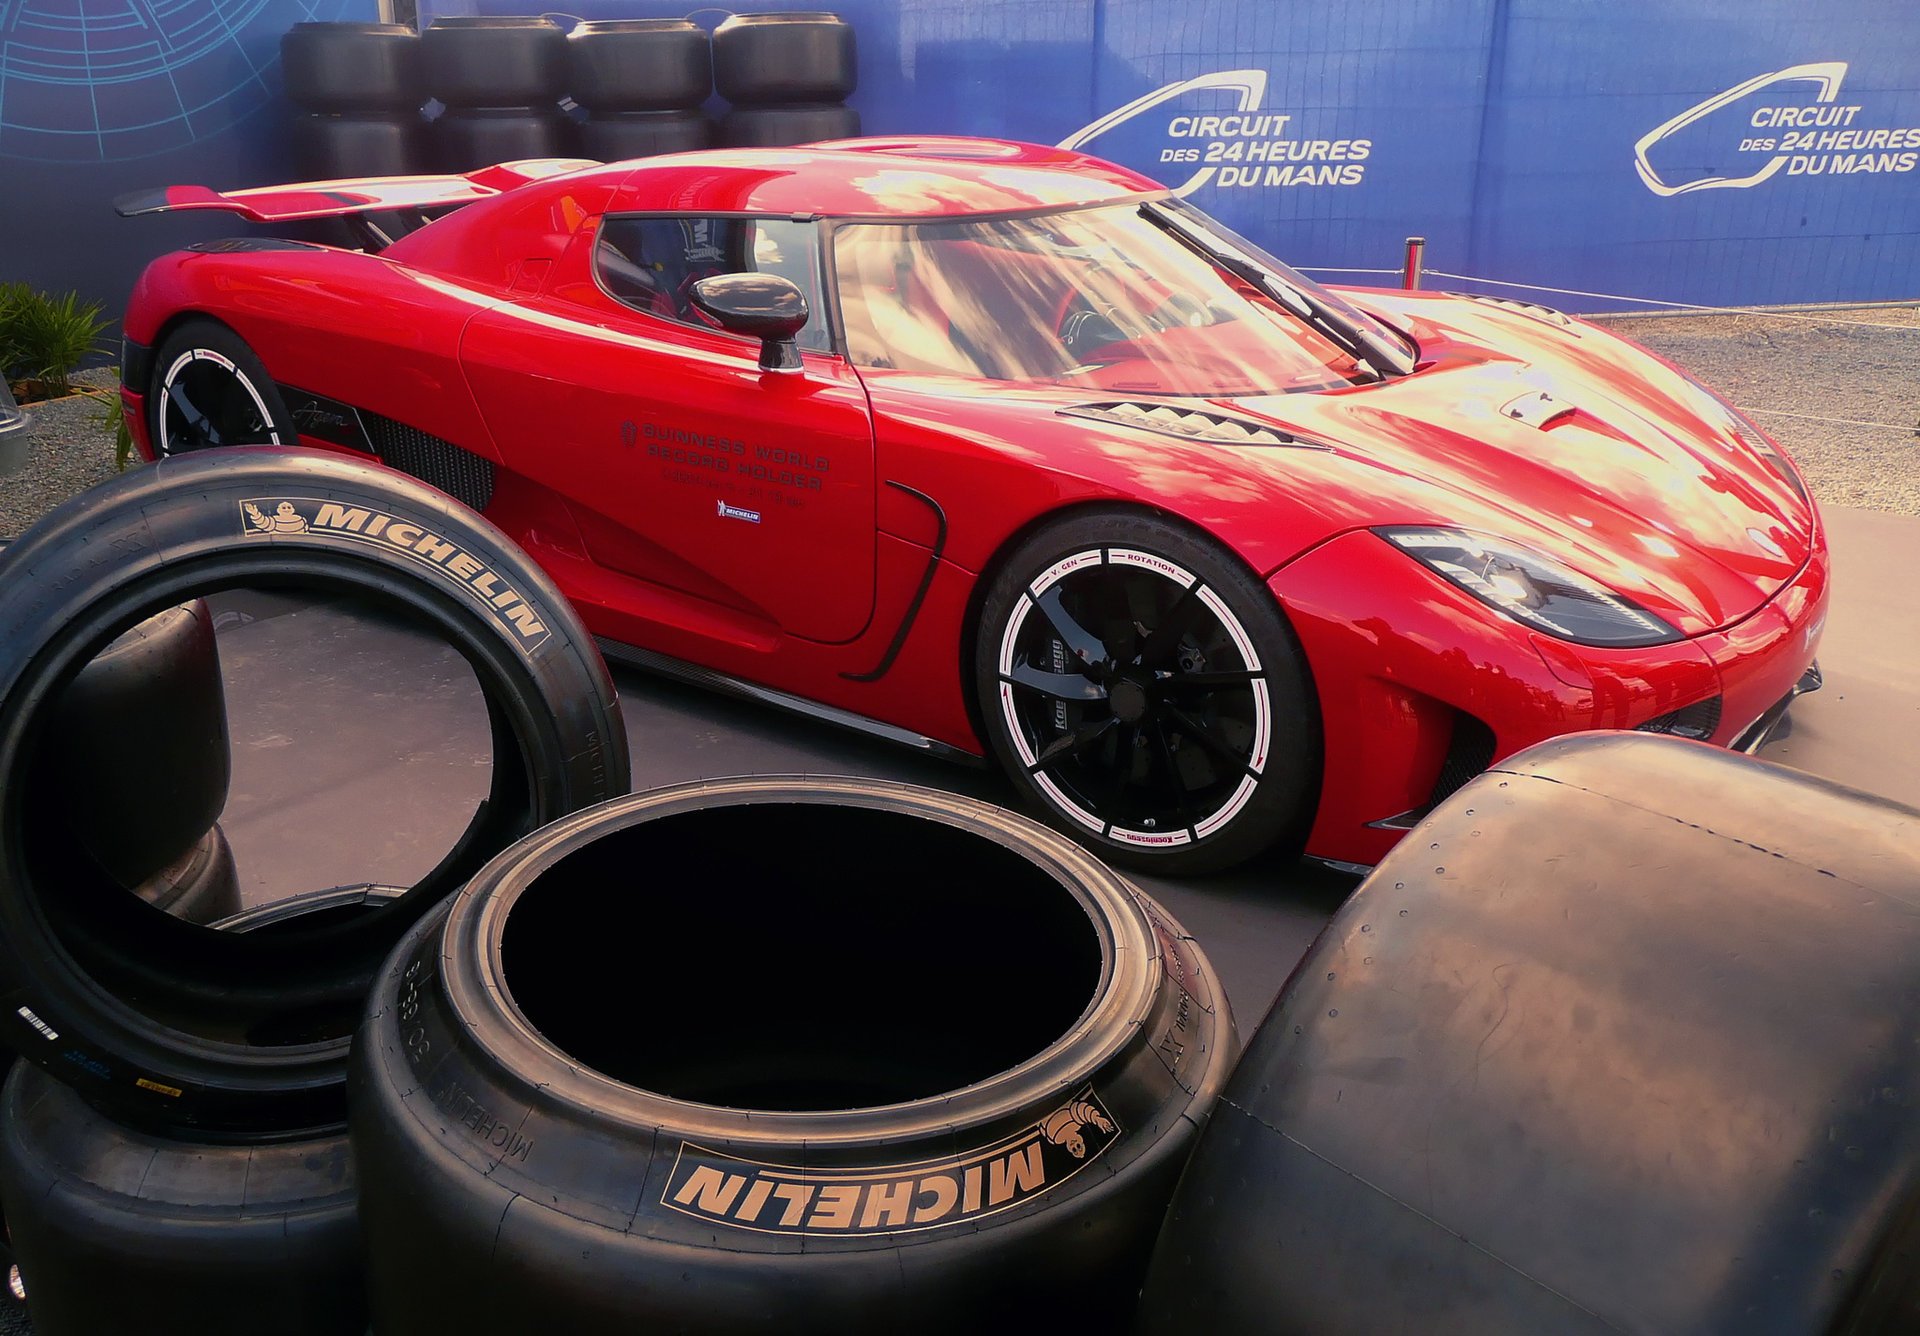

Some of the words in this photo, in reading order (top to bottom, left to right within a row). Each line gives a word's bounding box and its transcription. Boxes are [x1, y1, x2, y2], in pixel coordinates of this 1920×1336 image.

[1168, 115, 1290, 137] CIRCUIT
[1751, 106, 1861, 128] CIRCUIT
[1160, 149, 1200, 162] DES
[1204, 142, 1243, 162] 24
[1245, 140, 1372, 161] HEURES
[1738, 138, 1776, 152] DES
[1778, 131, 1815, 151] 24
[1815, 129, 1920, 150] HEURES
[1787, 155, 1827, 175] DU
[1828, 152, 1918, 175] MANS
[1217, 166, 1261, 187] DU
[1263, 164, 1365, 186] MANS
[642, 423, 746, 456] GUINNESS
[754, 444, 830, 472] WORLD
[646, 444, 730, 472] RECORD
[737, 463, 822, 491] HOLDER
[725, 508, 760, 520] MICHELIN
[313, 503, 545, 637] MICHELIN
[1061, 560, 1078, 570] GEN
[1127, 553, 1176, 574] ROTATION
[440, 1082, 534, 1162] MICHELIN
[673, 1141, 1046, 1228] MICHELIN
